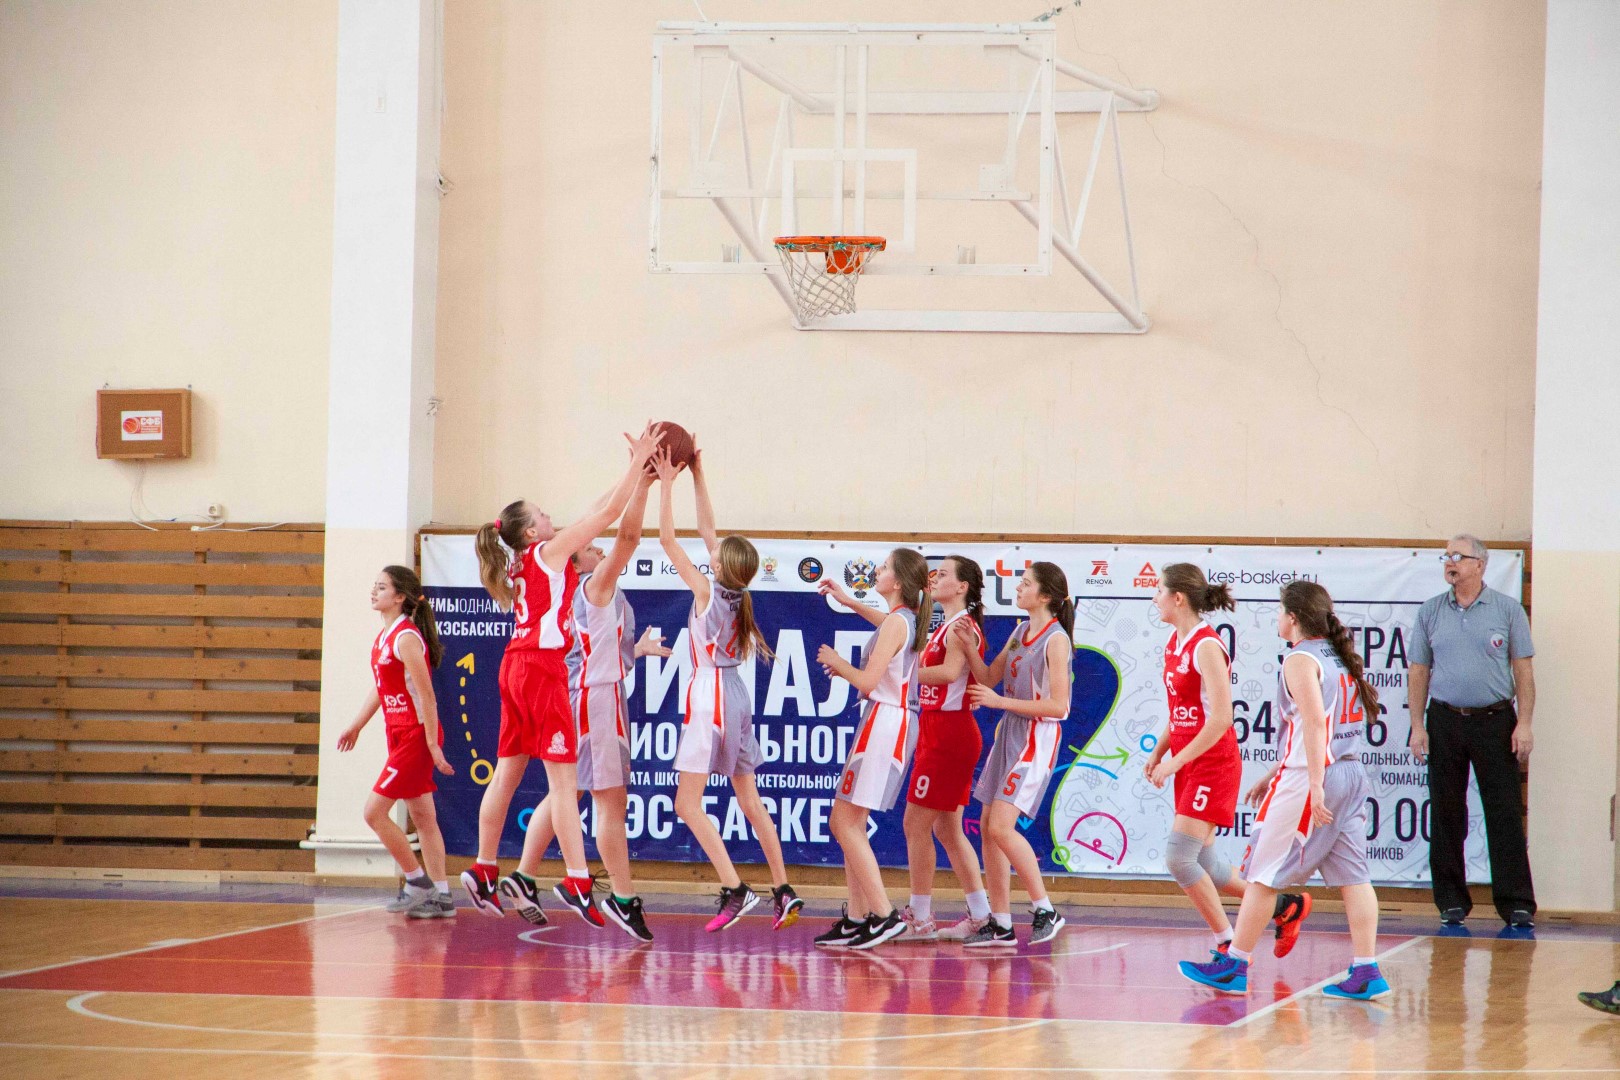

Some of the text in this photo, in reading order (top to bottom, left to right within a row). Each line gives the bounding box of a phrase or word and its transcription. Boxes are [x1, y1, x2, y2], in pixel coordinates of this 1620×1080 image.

[1086, 578, 1113, 586] RENOVA
[1133, 577, 1160, 588] PEAK
[1208, 569, 1317, 585] kes-basketru
[384, 693, 407, 707] КЭС
[1339, 672, 1363, 725] 12
[1173, 705, 1198, 720] КЭС
[380, 766, 398, 789] 7
[841, 770, 855, 795] 8
[914, 775, 930, 799] 9
[1003, 773, 1021, 797] 5
[1192, 785, 1211, 812] 5
